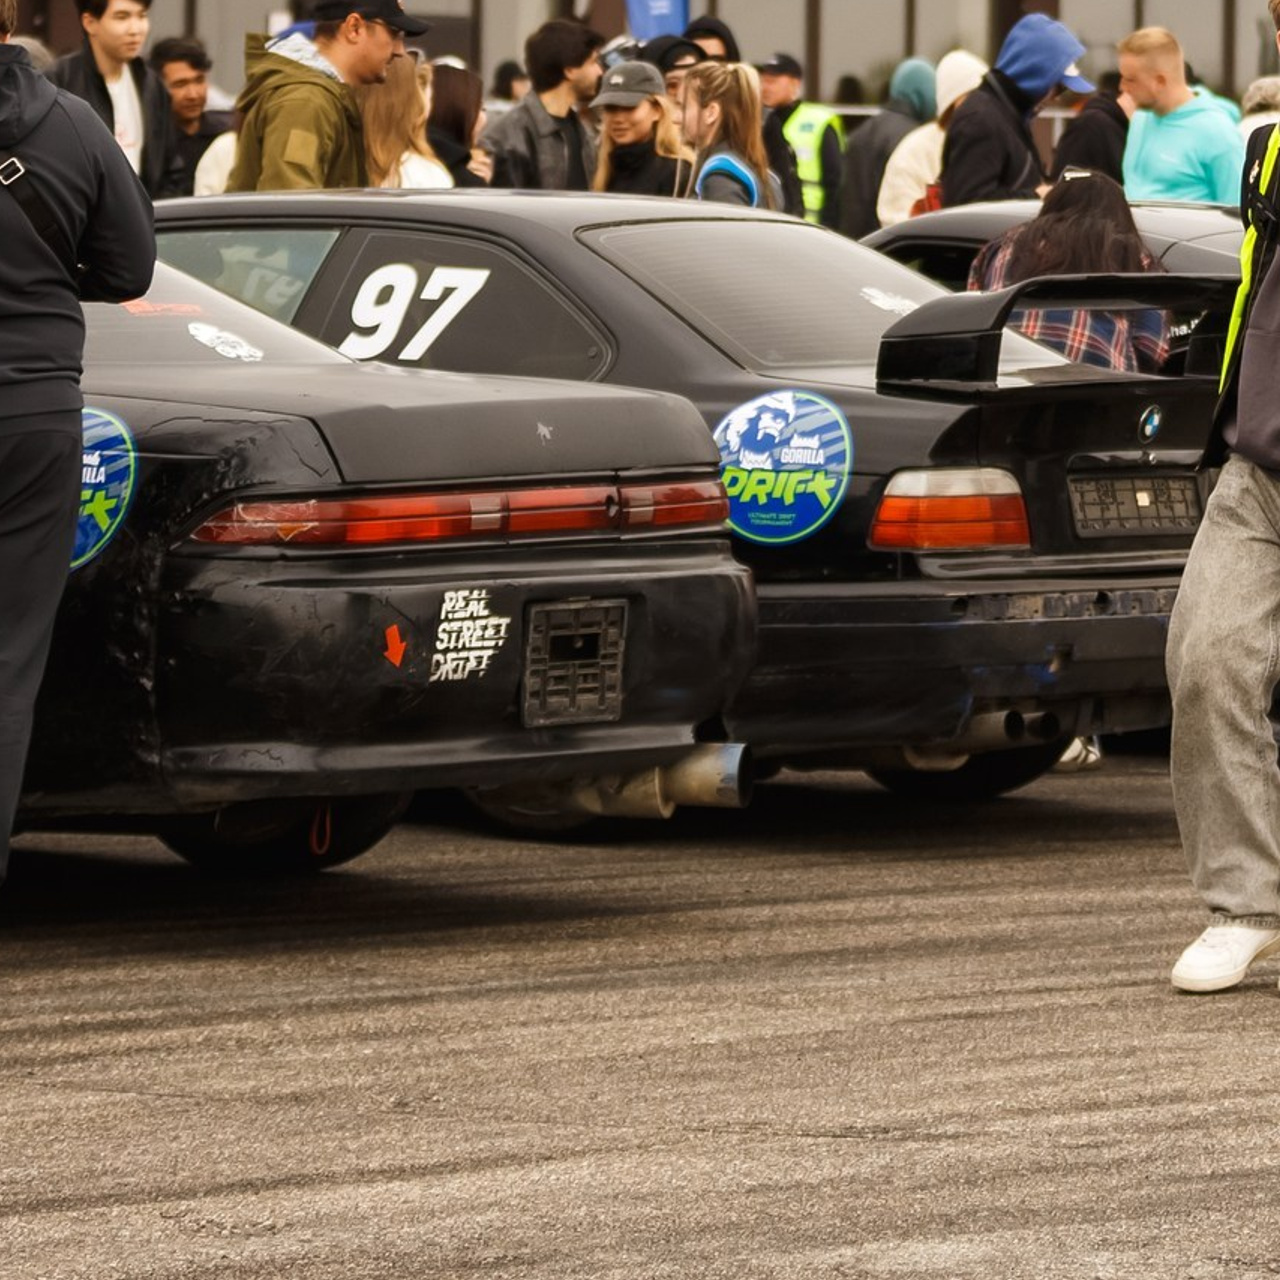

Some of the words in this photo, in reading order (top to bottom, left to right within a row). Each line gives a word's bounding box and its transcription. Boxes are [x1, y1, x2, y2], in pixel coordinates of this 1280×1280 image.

[337, 263, 491, 361] 97
[780, 447, 825, 465] GORILLA
[81, 467, 106, 484] ILLA
[722, 465, 837, 509] DRIFT
[440, 589, 490, 619] REAL
[435, 617, 512, 650] STREET
[428, 649, 493, 682] DRIFT
